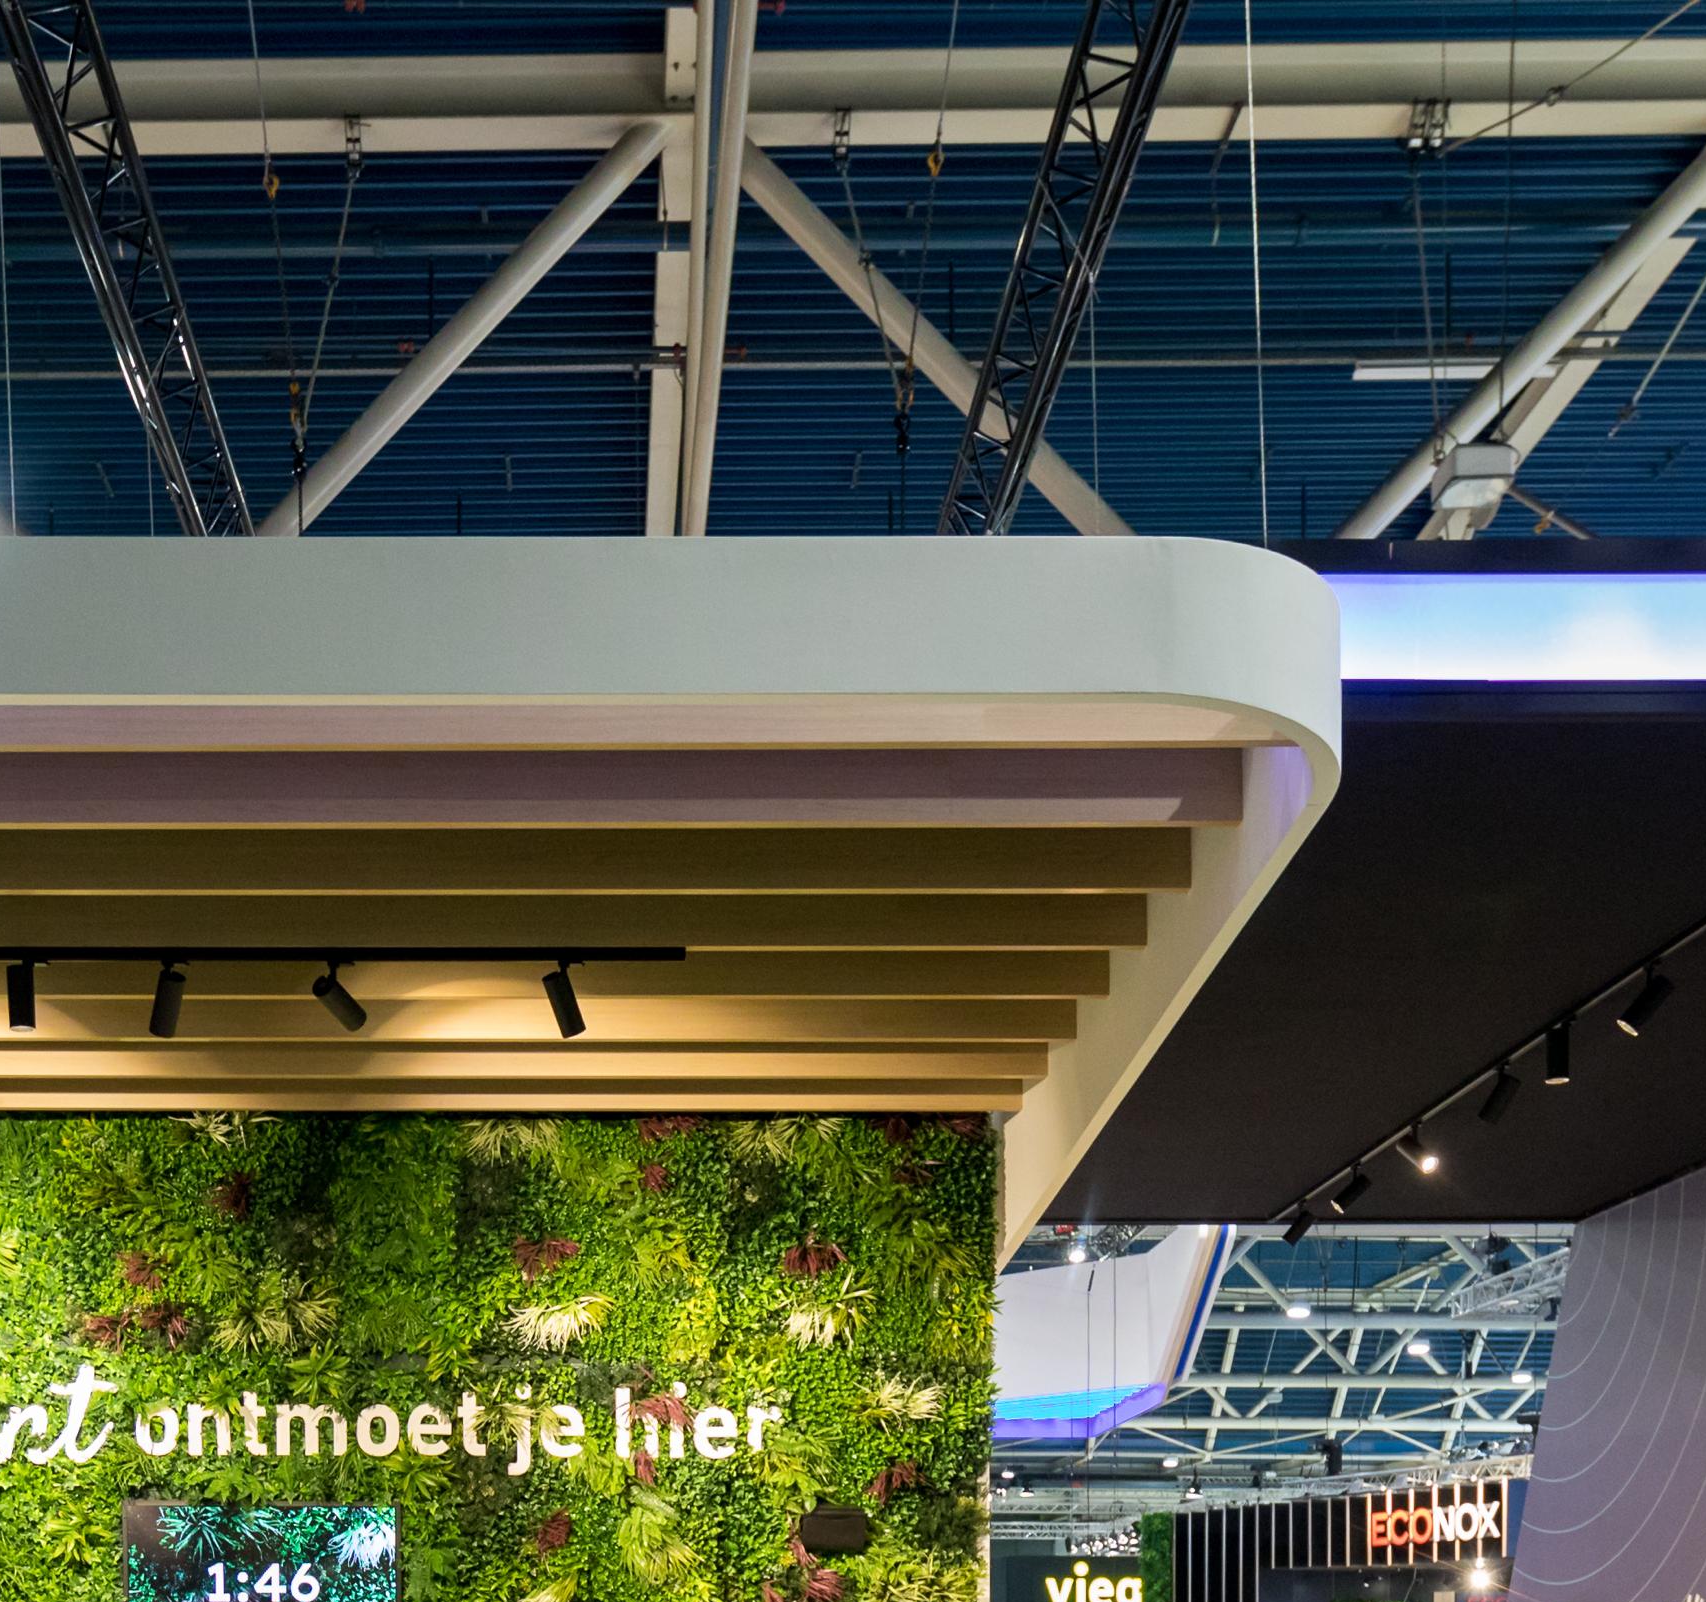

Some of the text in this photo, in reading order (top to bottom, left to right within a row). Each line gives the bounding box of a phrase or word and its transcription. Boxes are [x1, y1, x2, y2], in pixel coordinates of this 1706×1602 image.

[134, 1391, 487, 1457] ontmoet
[507, 1382, 585, 1476] je
[614, 1381, 782, 1460] hier
[1371, 1501, 1501, 1548] ECONOX
